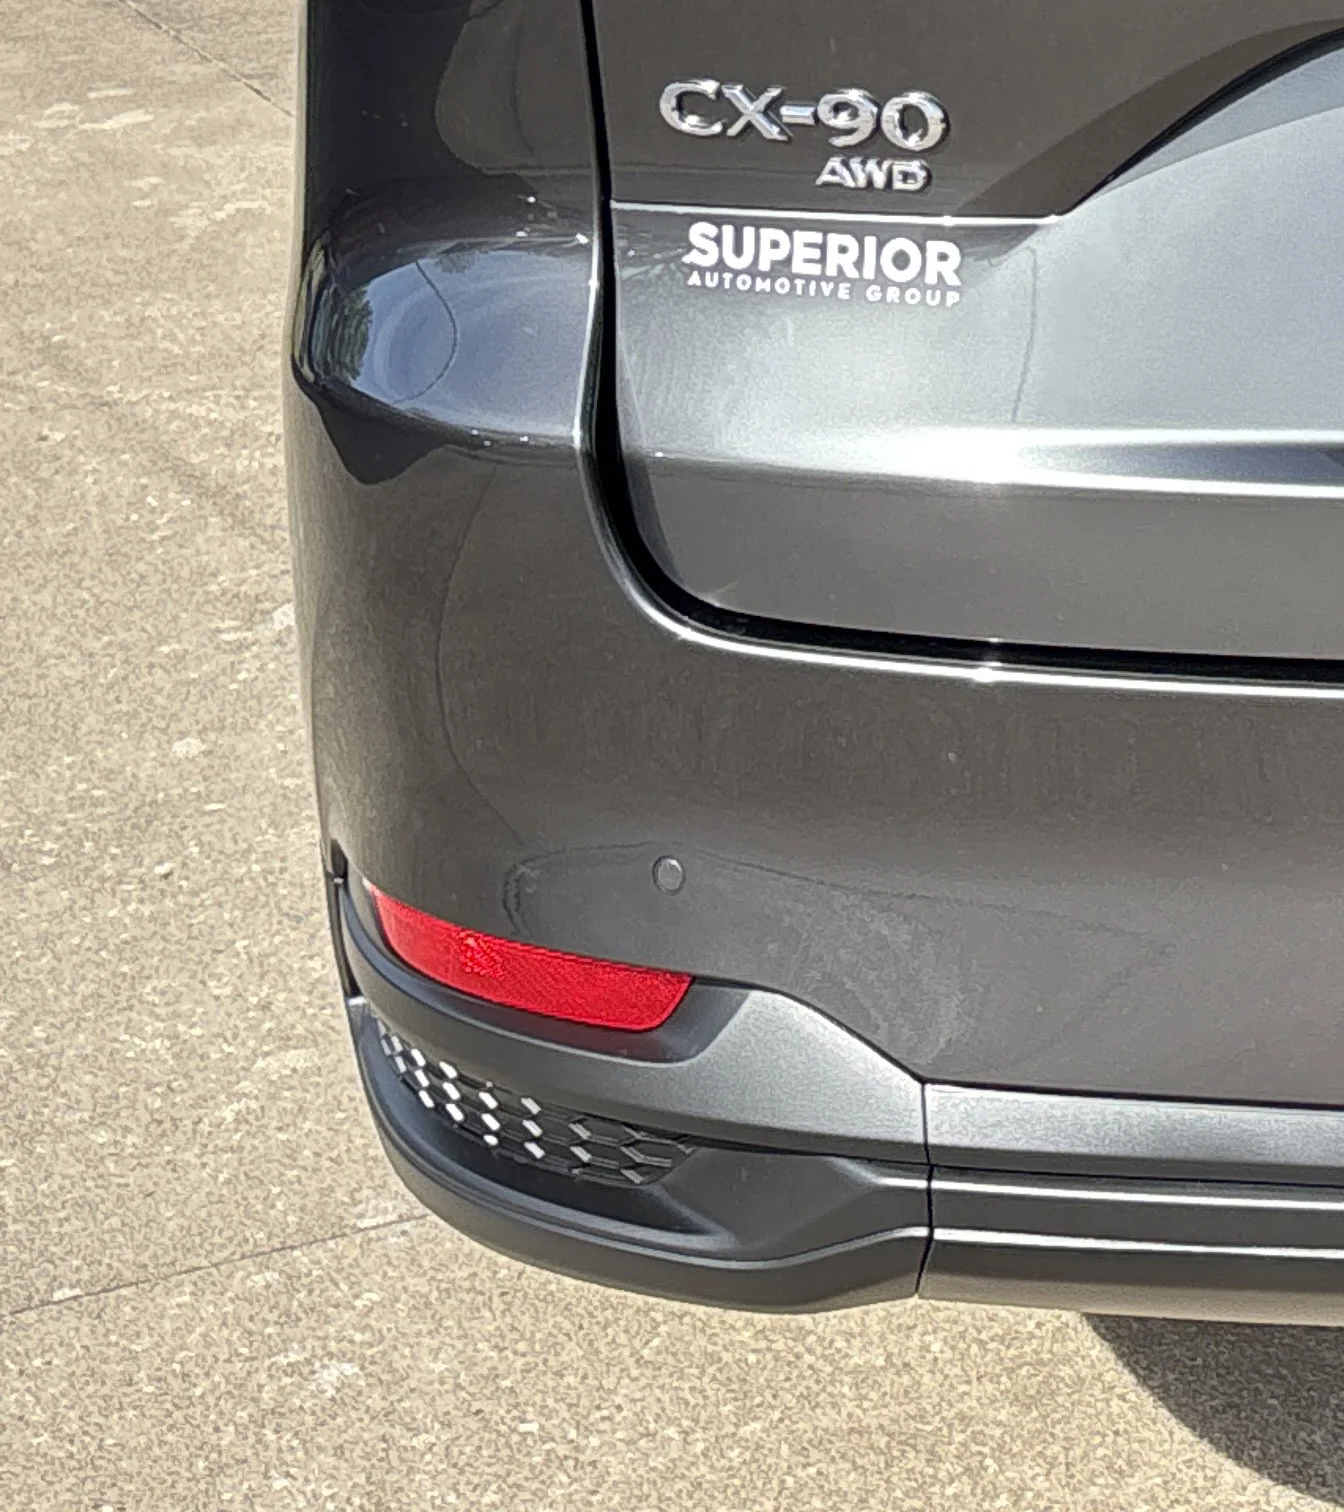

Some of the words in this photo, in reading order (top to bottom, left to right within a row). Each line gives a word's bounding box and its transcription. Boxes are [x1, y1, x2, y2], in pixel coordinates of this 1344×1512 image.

[659, 79, 950, 152] CX-90
[815, 156, 932, 192] AWD
[685, 221, 962, 287] SUPERIOR
[687, 271, 851, 301] AUTOMOTIVE
[866, 285, 961, 308] GROUP
